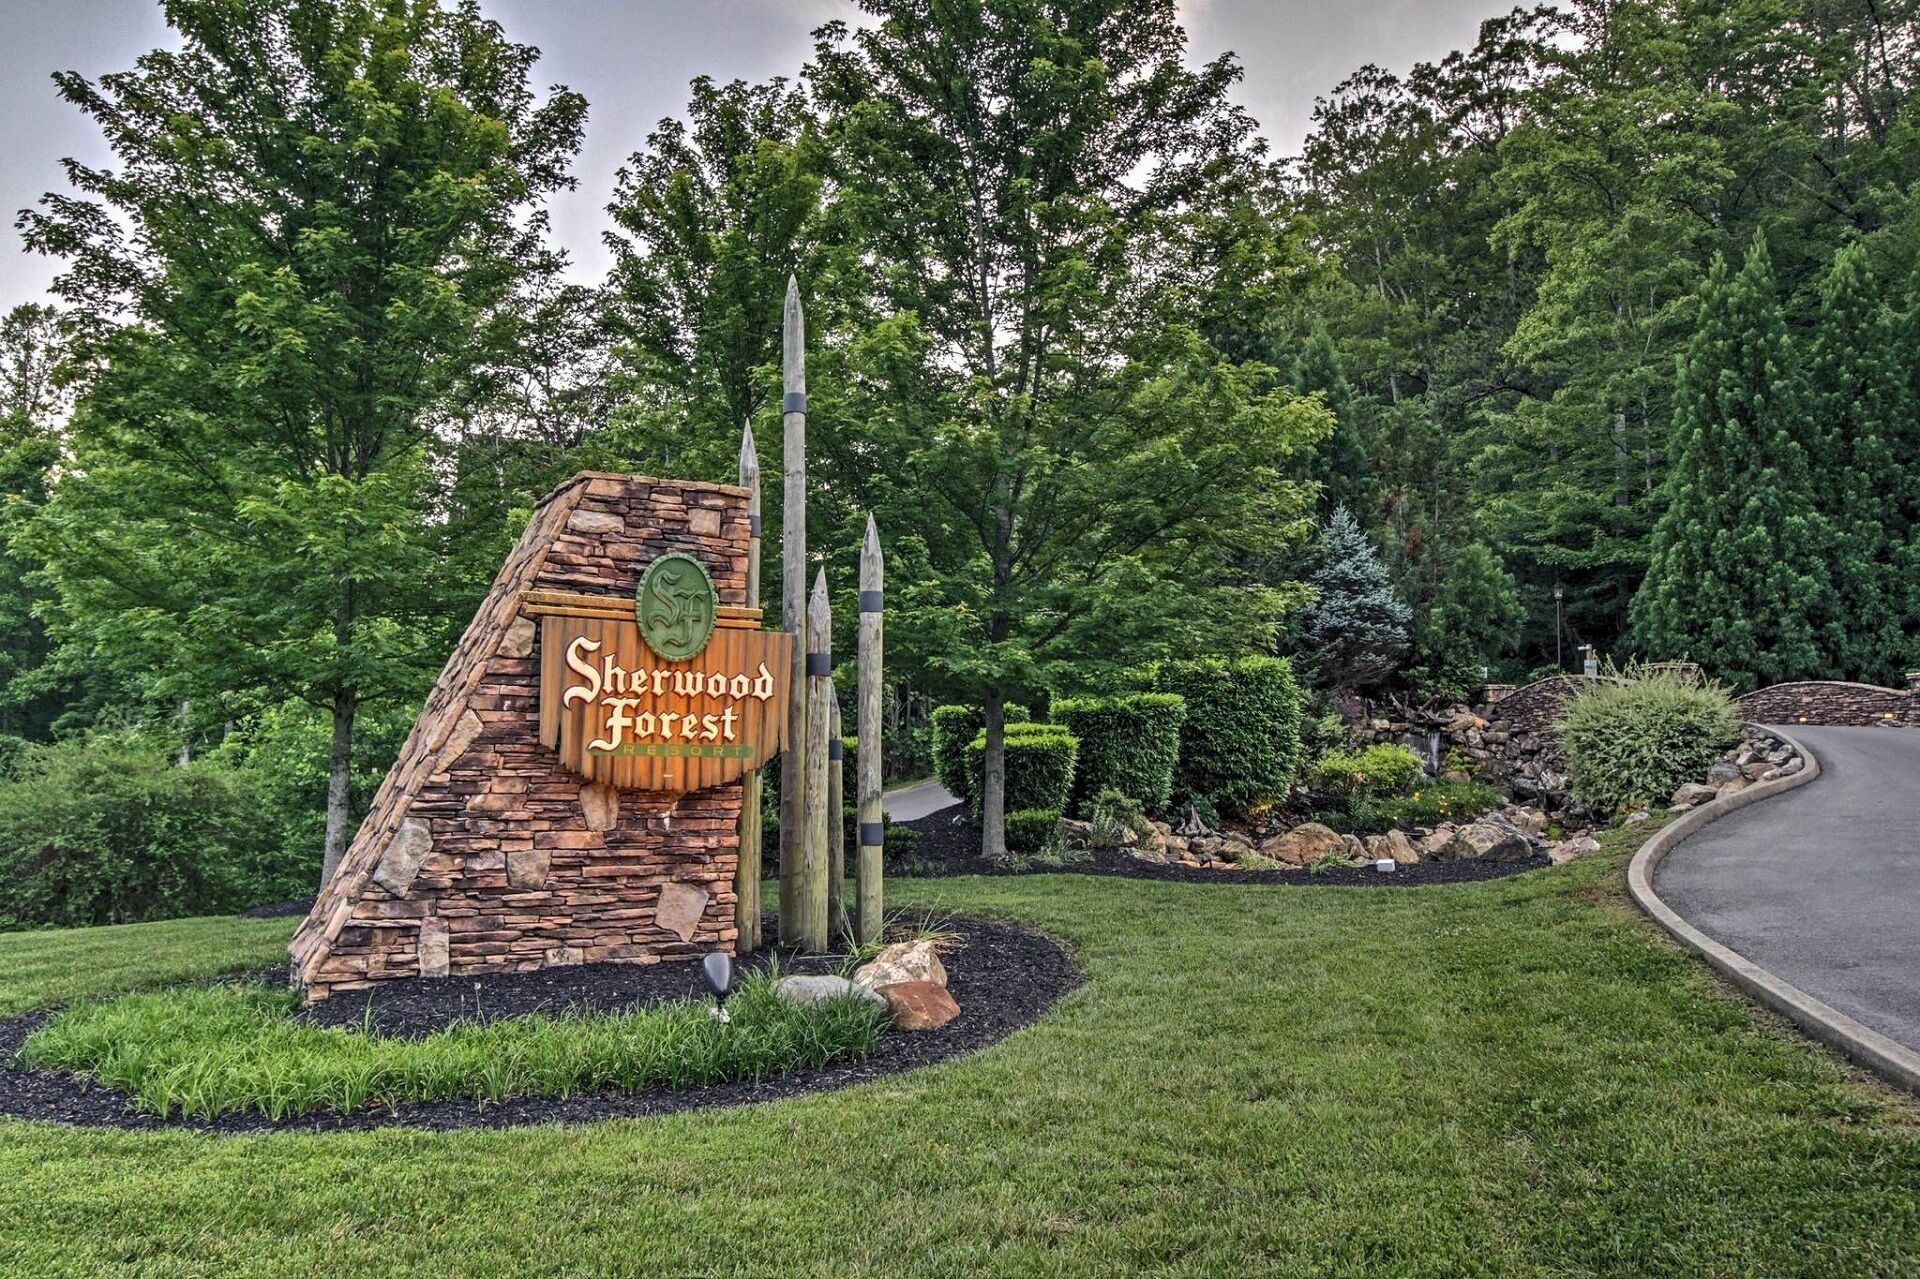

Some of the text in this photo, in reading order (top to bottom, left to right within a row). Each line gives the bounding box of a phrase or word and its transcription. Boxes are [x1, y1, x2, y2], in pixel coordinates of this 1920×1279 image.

[563, 635, 775, 710] Sherwood
[588, 697, 739, 751] Forest
[623, 744, 742, 756] RESORT
